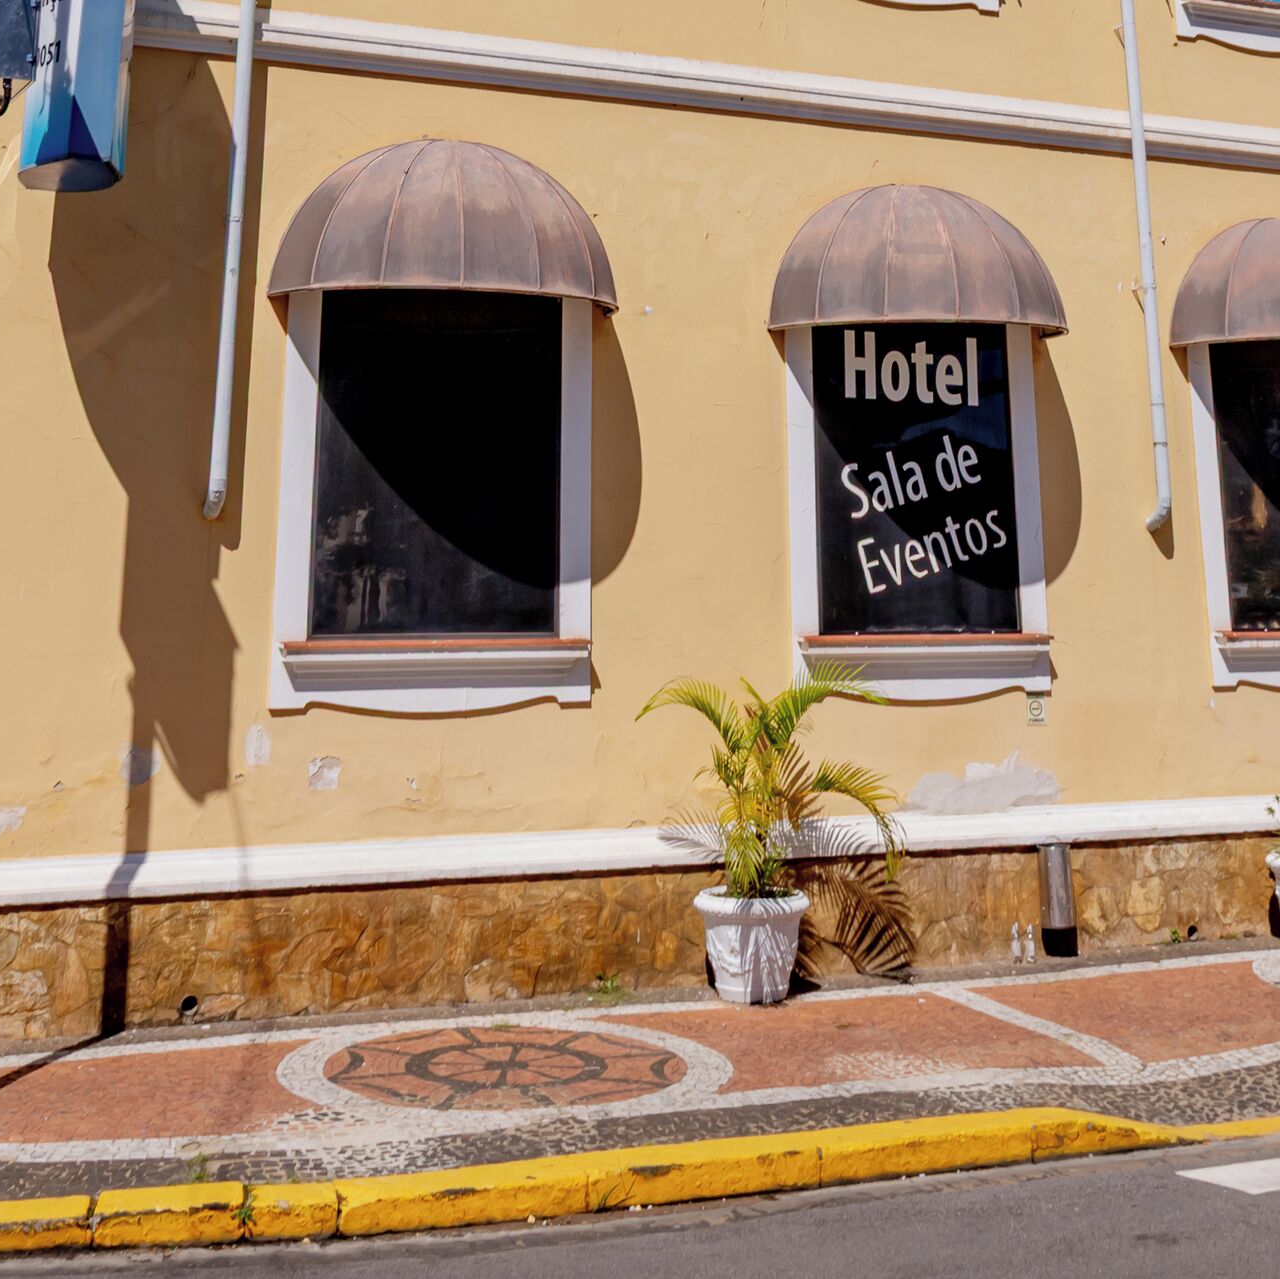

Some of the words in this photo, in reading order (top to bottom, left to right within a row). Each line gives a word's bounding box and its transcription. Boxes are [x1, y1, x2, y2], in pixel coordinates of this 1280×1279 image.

[844, 330, 979, 406] Hotel
[841, 451, 928, 518] Sala
[935, 435, 982, 492] de
[857, 509, 1007, 594] Eventos
